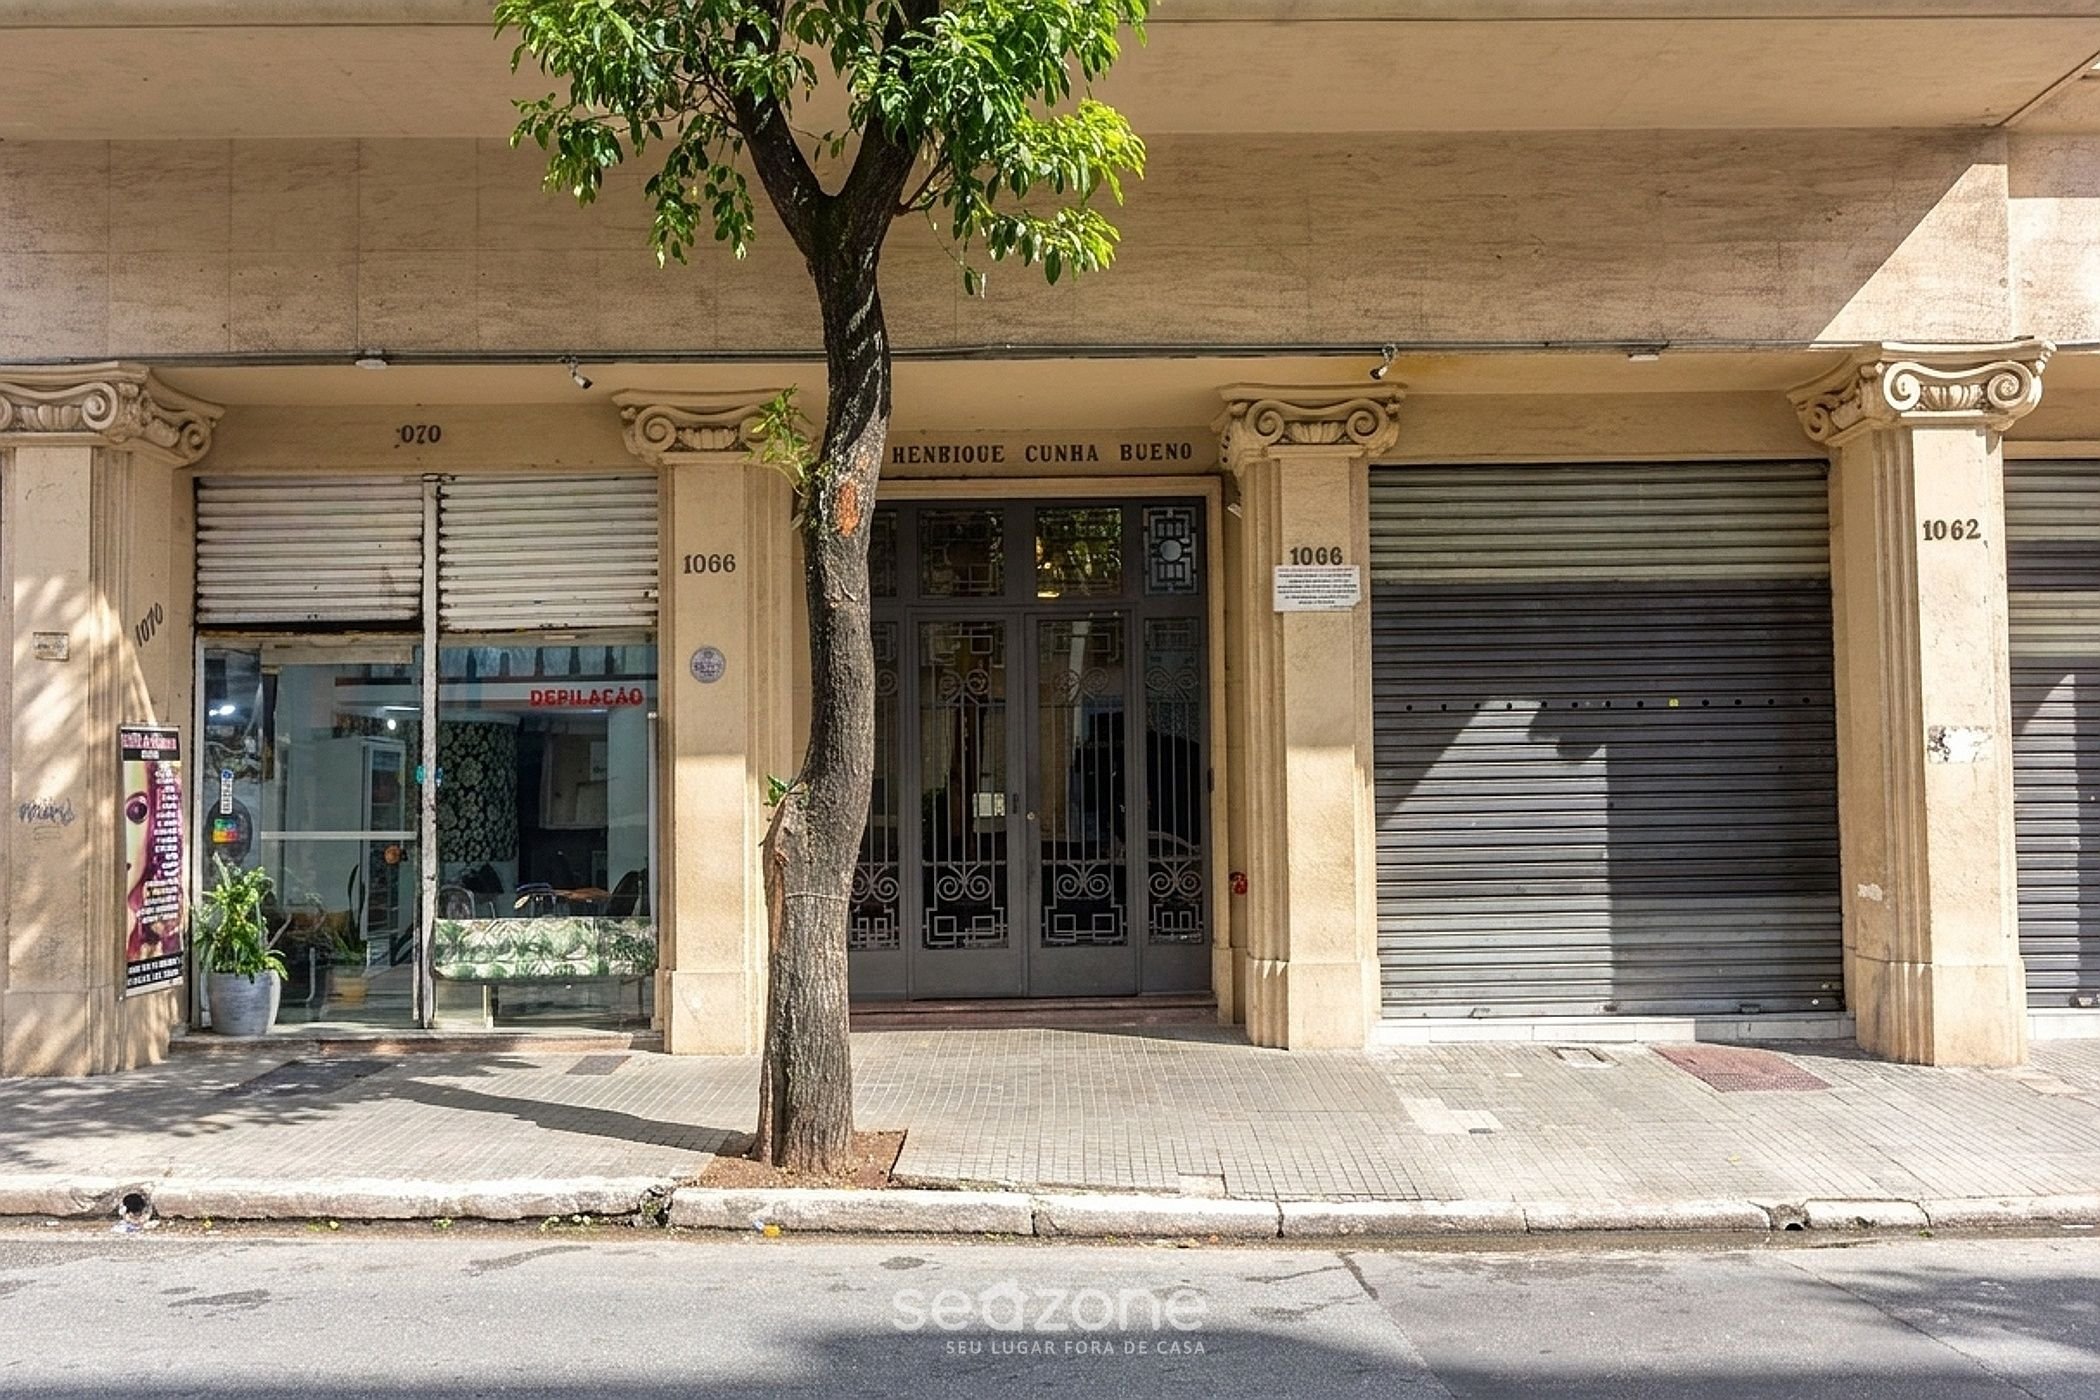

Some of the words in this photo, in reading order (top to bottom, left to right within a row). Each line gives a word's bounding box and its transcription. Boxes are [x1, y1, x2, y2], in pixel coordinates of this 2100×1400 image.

[400, 424, 442, 444] 070
[1025, 444, 1099, 463] CUNHA
[1120, 442, 1193, 461] BUENO
[1922, 518, 1982, 541] 1062
[683, 553, 737, 574] 1066
[1289, 546, 1343, 566] 1066
[135, 602, 164, 648] 1070
